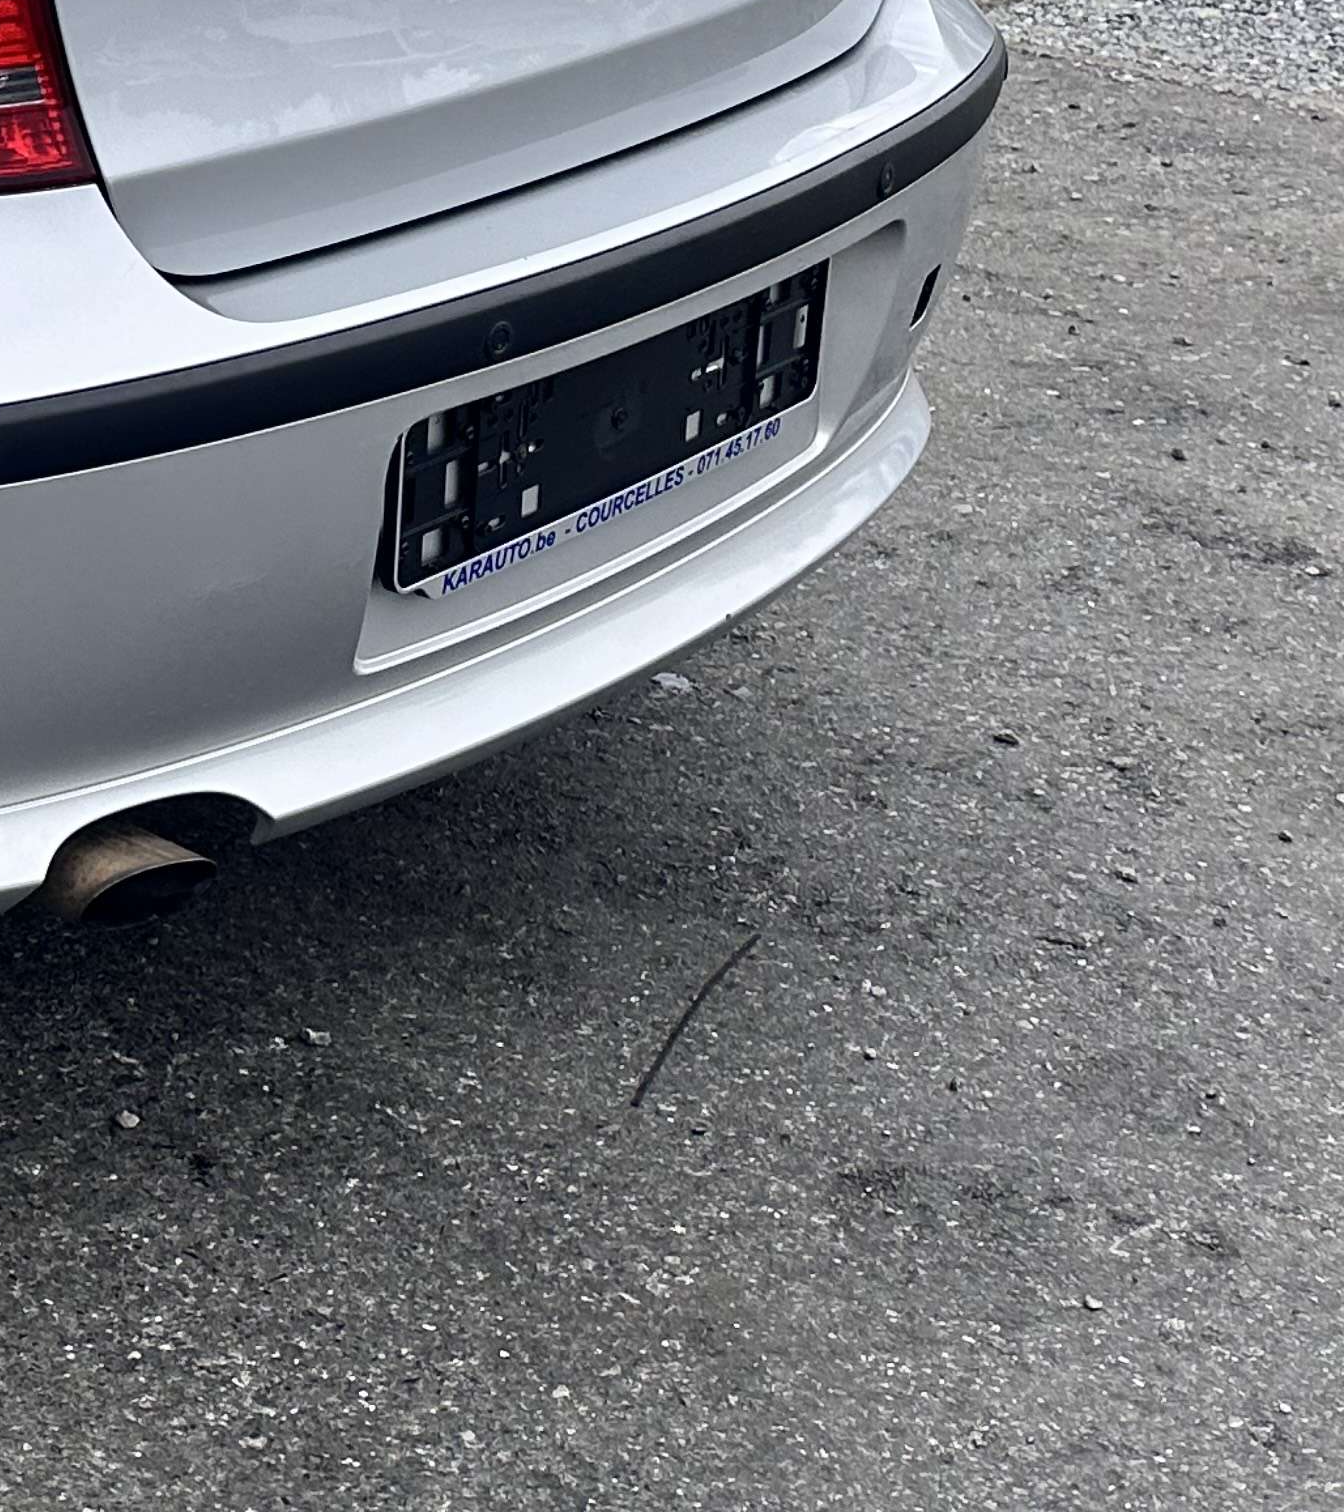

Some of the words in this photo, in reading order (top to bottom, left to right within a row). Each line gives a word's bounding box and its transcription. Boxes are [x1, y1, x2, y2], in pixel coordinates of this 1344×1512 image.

[441, 530, 557, 595] KARAUTO.be
[576, 466, 684, 533] COURCELLES
[697, 417, 781, 475] 071.45.17.60
